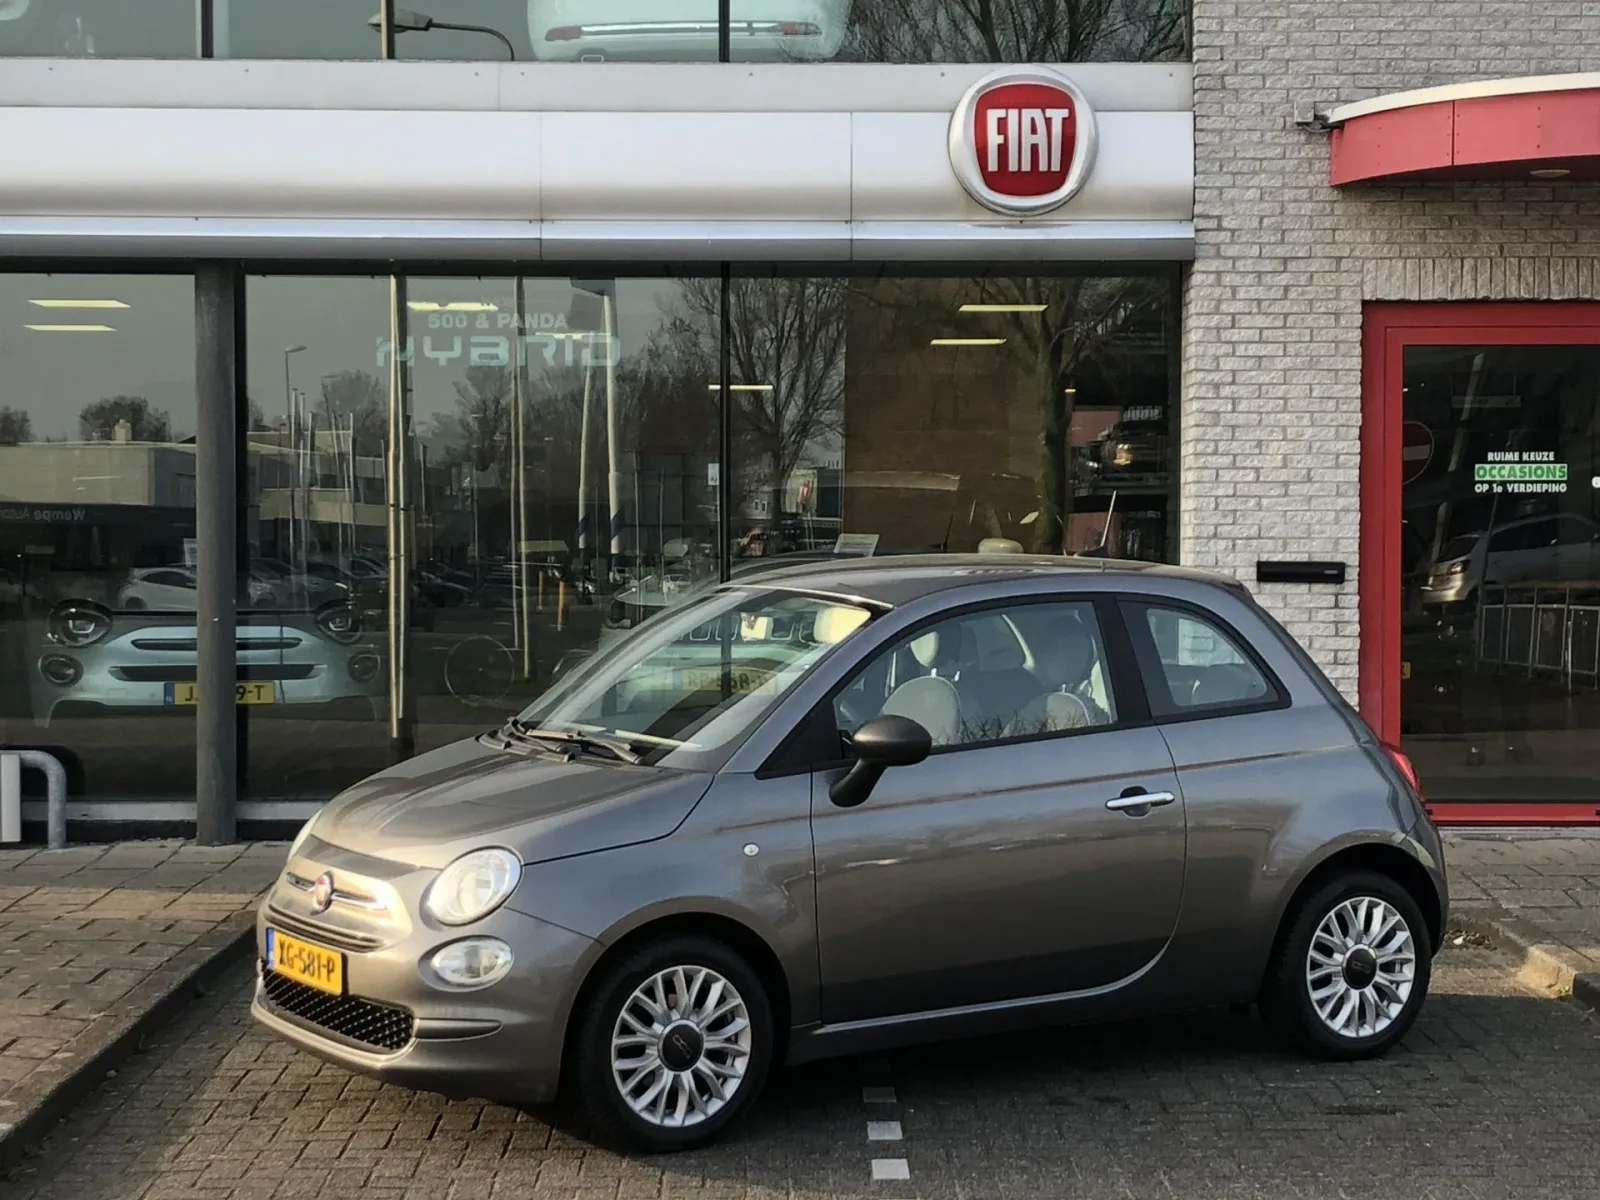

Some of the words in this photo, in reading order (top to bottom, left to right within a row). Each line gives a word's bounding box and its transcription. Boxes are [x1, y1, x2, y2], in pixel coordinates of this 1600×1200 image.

[986, 108, 1069, 172] FIAT
[428, 313, 468, 329] 500
[475, 313, 490, 329] &
[496, 313, 569, 329] PANDA
[1487, 451, 1520, 461] RUIME
[1522, 451, 1555, 461] KEUZE
[1476, 465, 1567, 479] OCCASIONS
[1474, 483, 1489, 493] OP
[279, 940, 336, 983] XG-581-P
